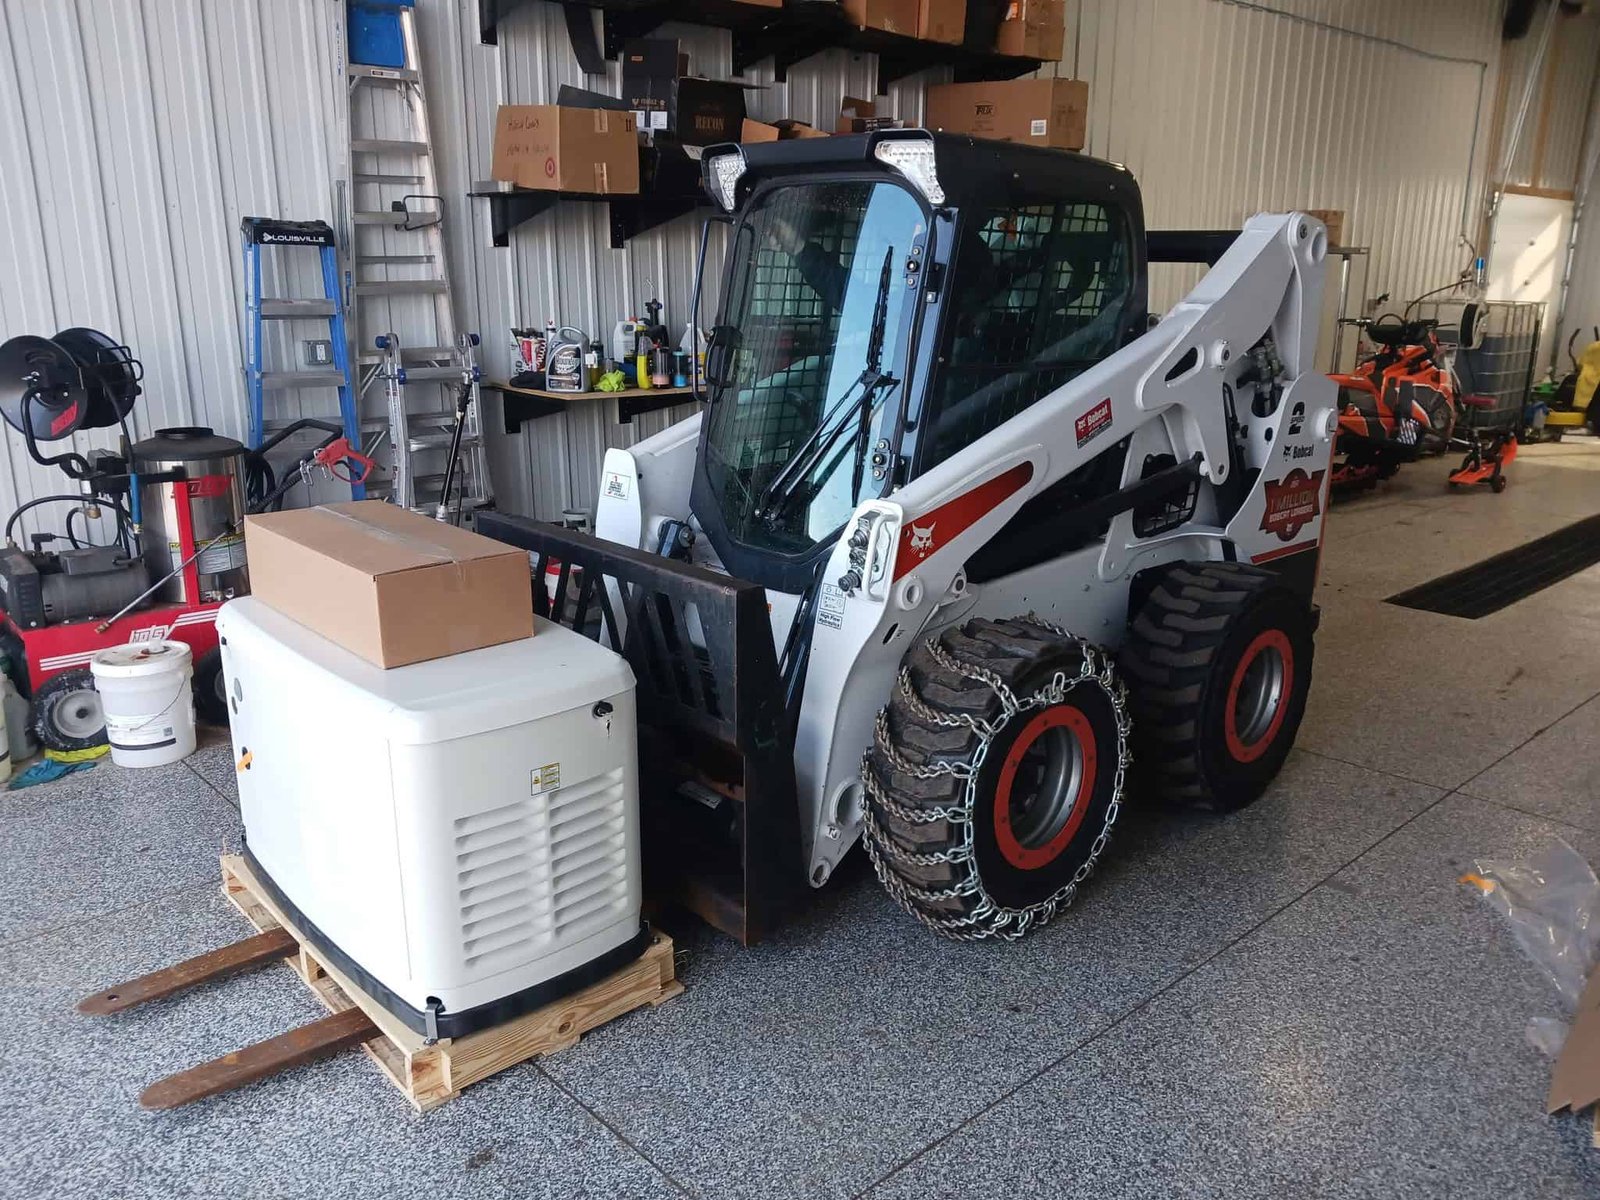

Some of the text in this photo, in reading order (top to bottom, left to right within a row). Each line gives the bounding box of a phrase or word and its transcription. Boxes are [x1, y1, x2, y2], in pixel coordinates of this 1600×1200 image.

[694, 114, 725, 131] RECON
[272, 234, 326, 243] LOUISVILLE
[1087, 405, 1107, 425] Bobcat
[1292, 443, 1315, 459] Bobcat
[1276, 490, 1317, 510] MILLION
[1269, 503, 1314, 523] BOBCAT LOADERS
